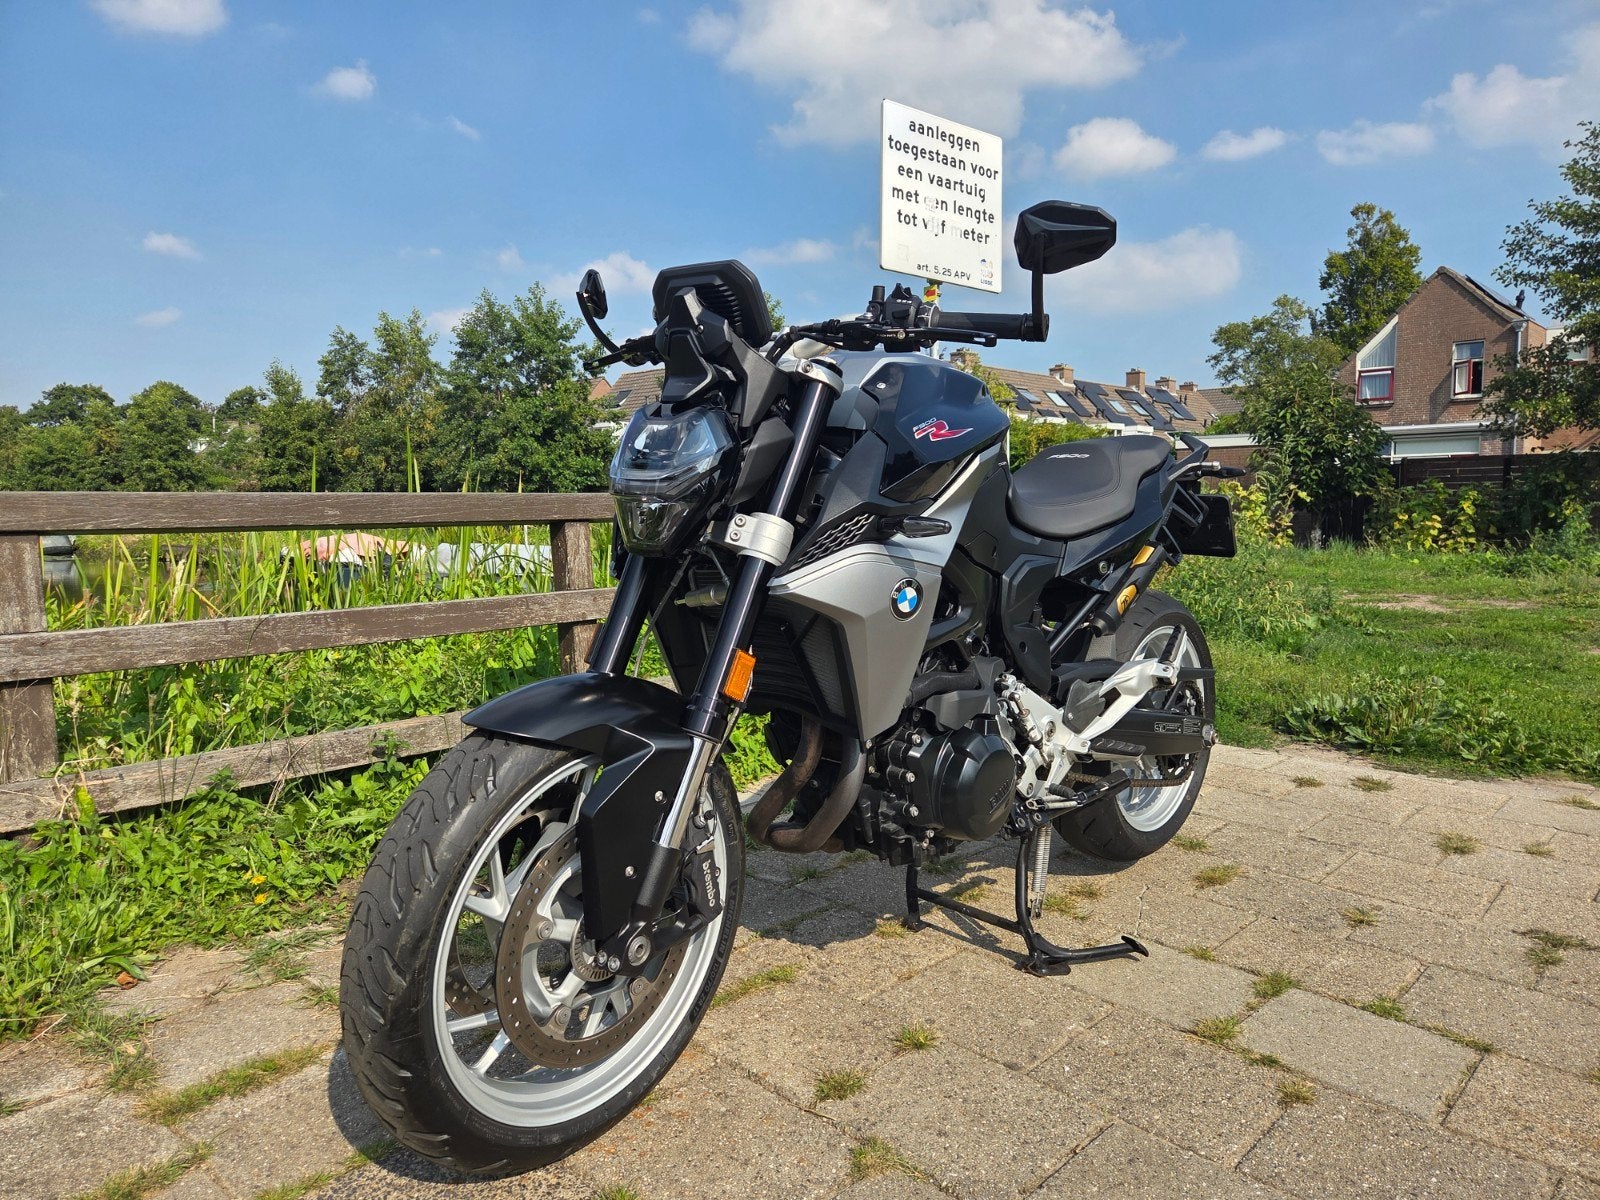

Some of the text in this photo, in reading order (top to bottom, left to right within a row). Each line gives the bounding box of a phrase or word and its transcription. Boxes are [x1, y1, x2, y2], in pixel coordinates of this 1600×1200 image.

[909, 120, 980, 152] aanleggen
[888, 134, 999, 180] toegestaan voor
[897, 165, 986, 203] een vaartuig
[892, 186, 995, 224] met en lengte
[897, 209, 917, 227] tot
[922, 217, 946, 237] vf
[917, 263, 971, 281] art. 5.25 APV
[702, 859, 715, 907] brembo
